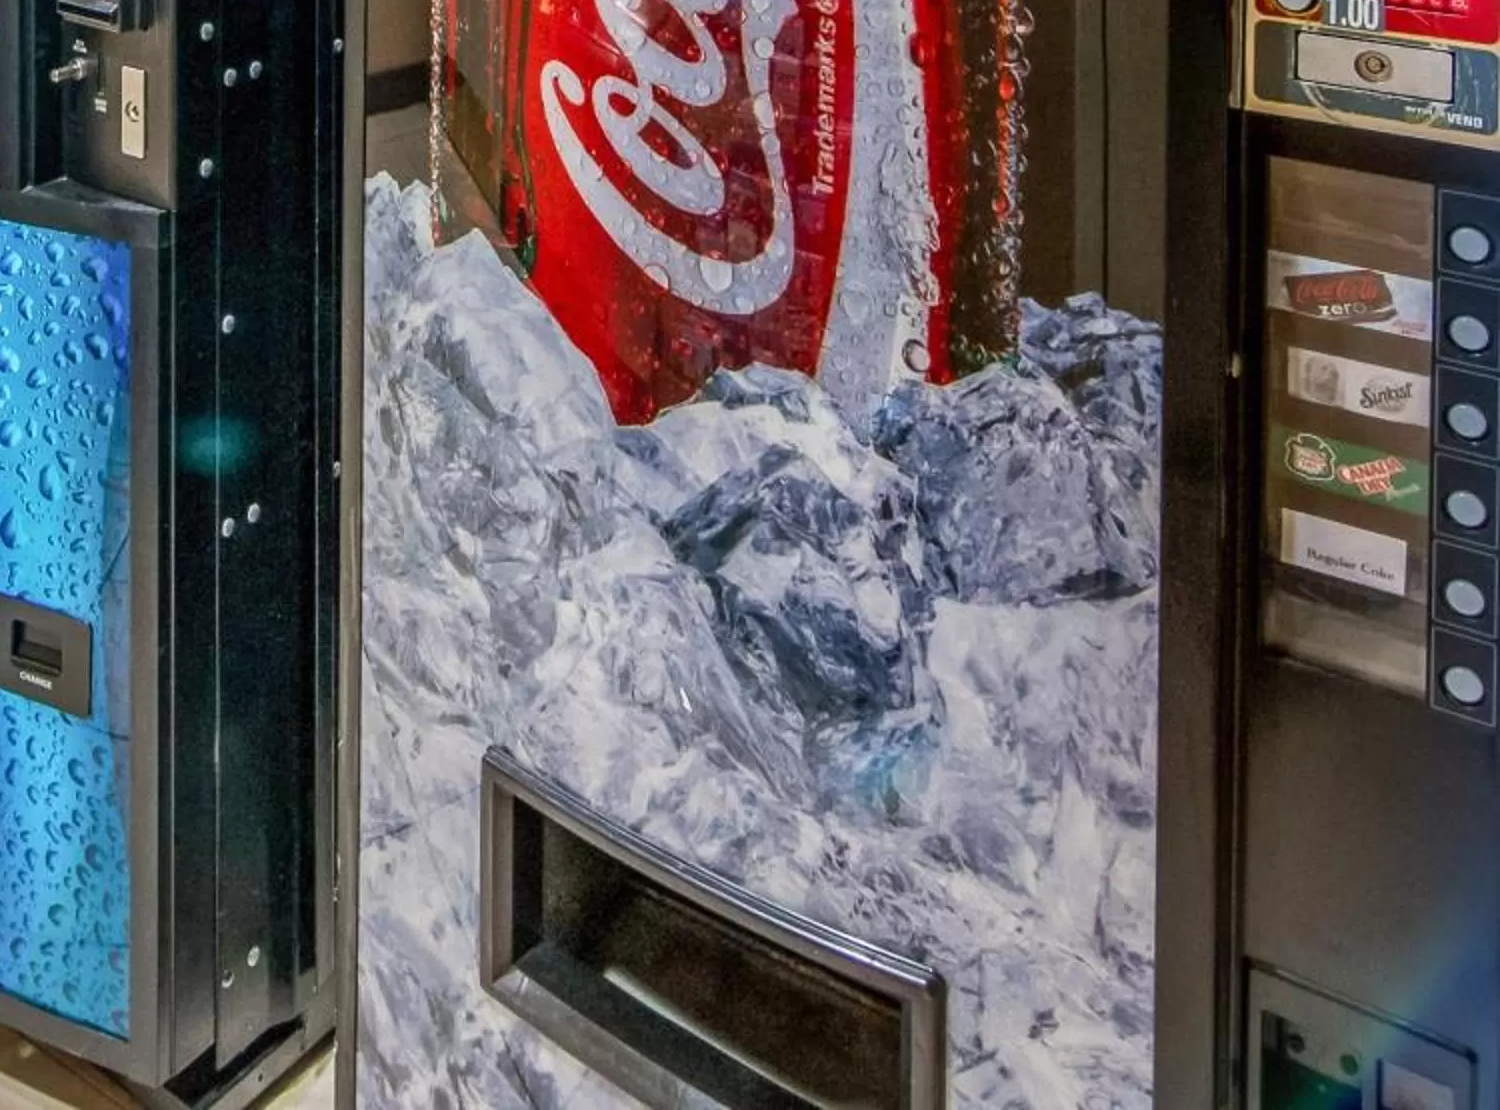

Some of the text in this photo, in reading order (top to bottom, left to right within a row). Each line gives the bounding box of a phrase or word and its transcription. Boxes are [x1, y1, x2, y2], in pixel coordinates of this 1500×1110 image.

[1317, 302, 1367, 316] zero
[1305, 546, 1395, 581] Regular Coke
